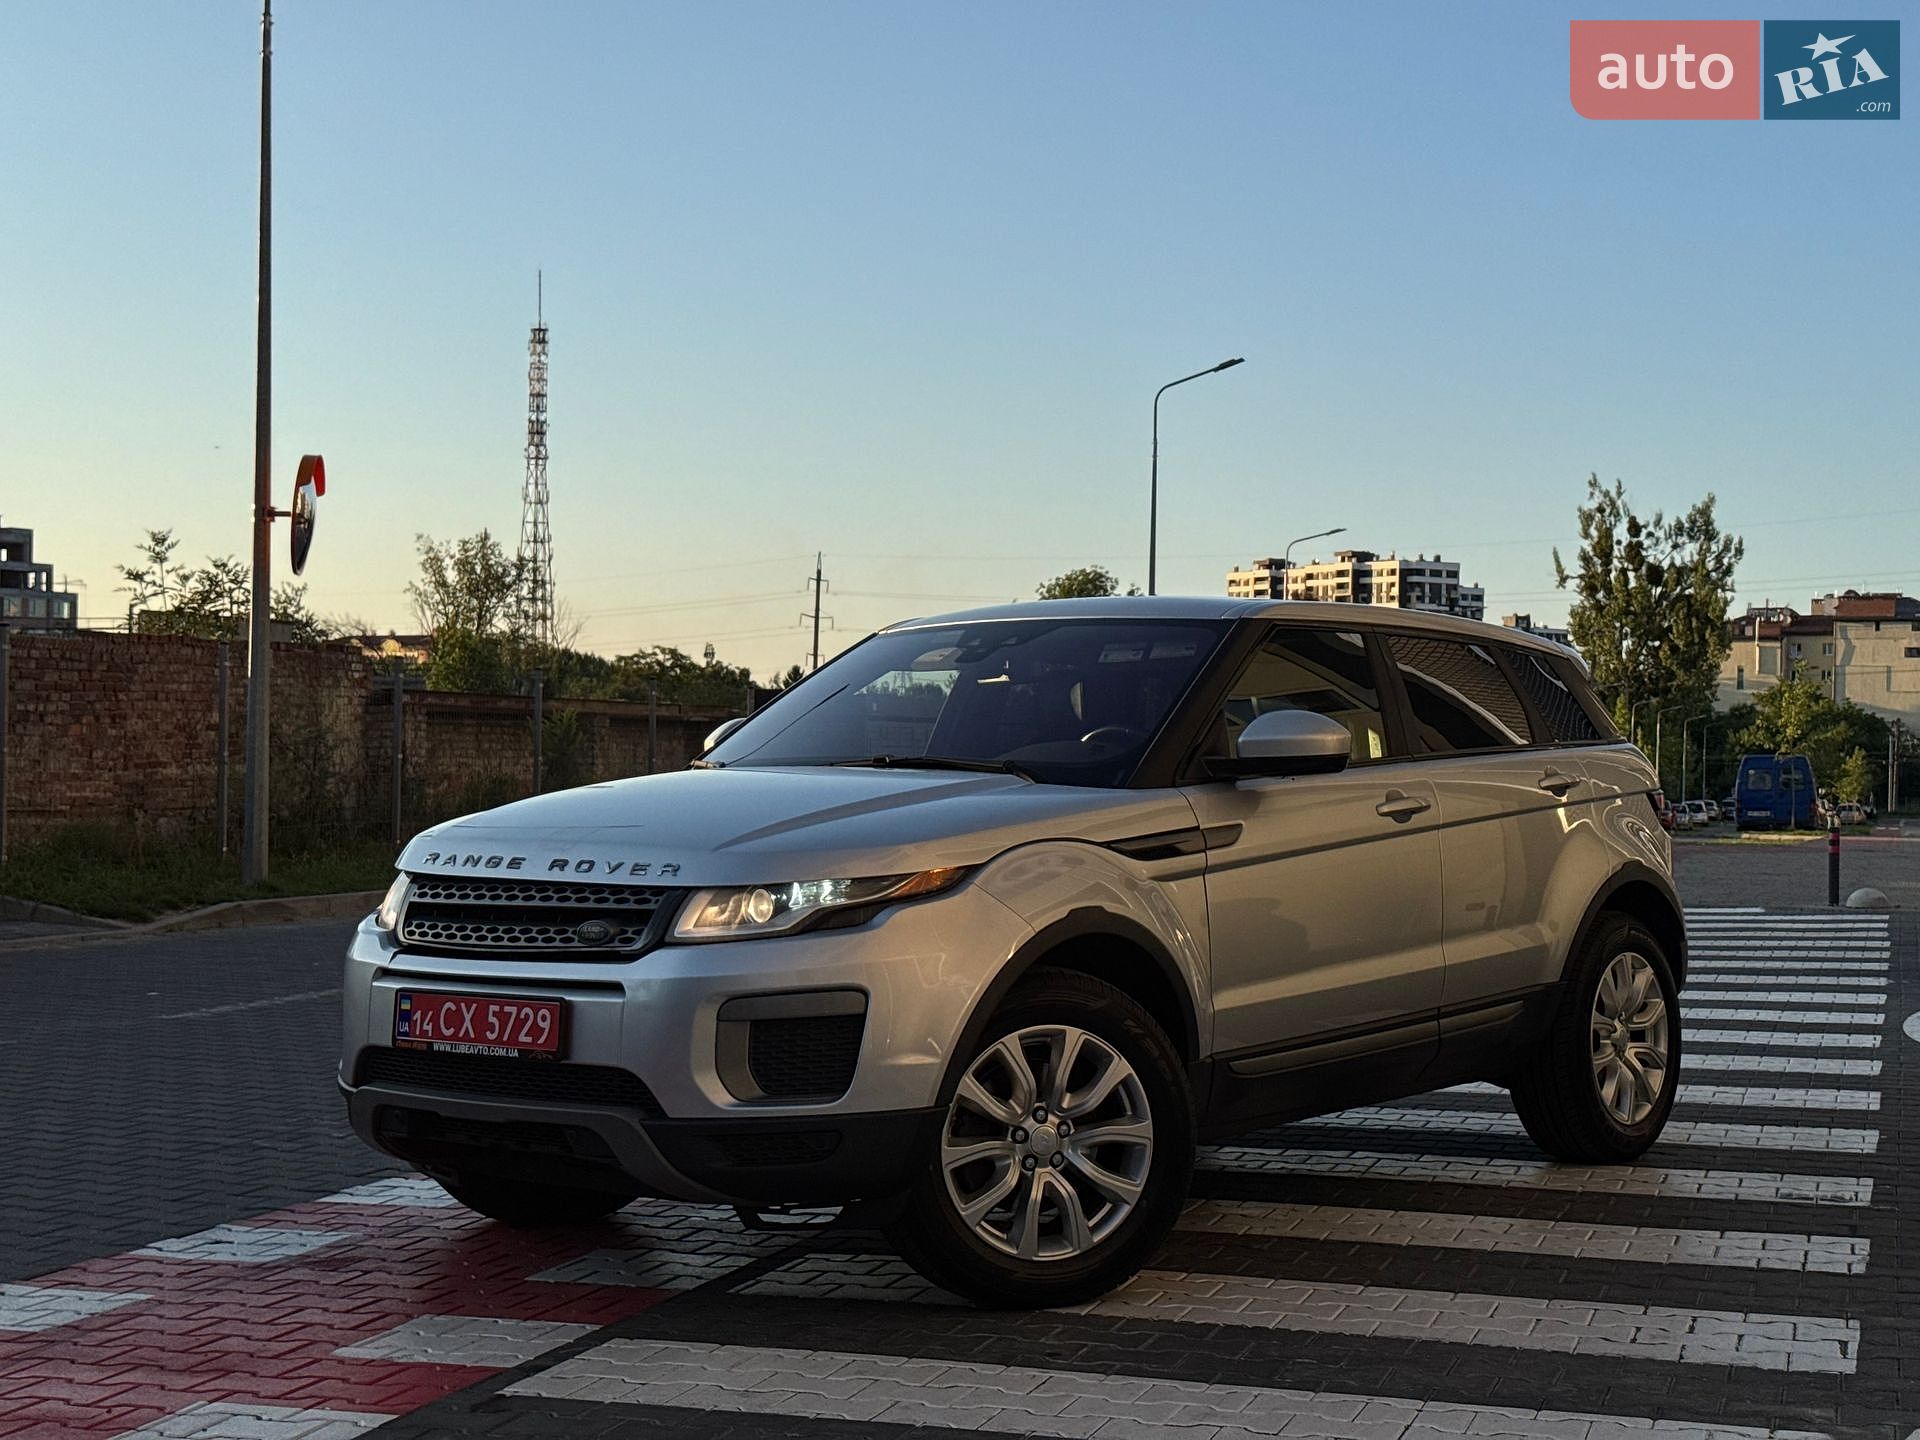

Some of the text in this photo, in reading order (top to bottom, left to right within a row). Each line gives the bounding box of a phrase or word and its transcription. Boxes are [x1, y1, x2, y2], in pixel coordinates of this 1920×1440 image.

[422, 852, 682, 877] RANGE ROVER
[399, 1021, 409, 1033] UA
[413, 1002, 551, 1044] 14 CX 5729
[433, 1042, 519, 1058] WWW.LUBEAVTO.COM.UA
